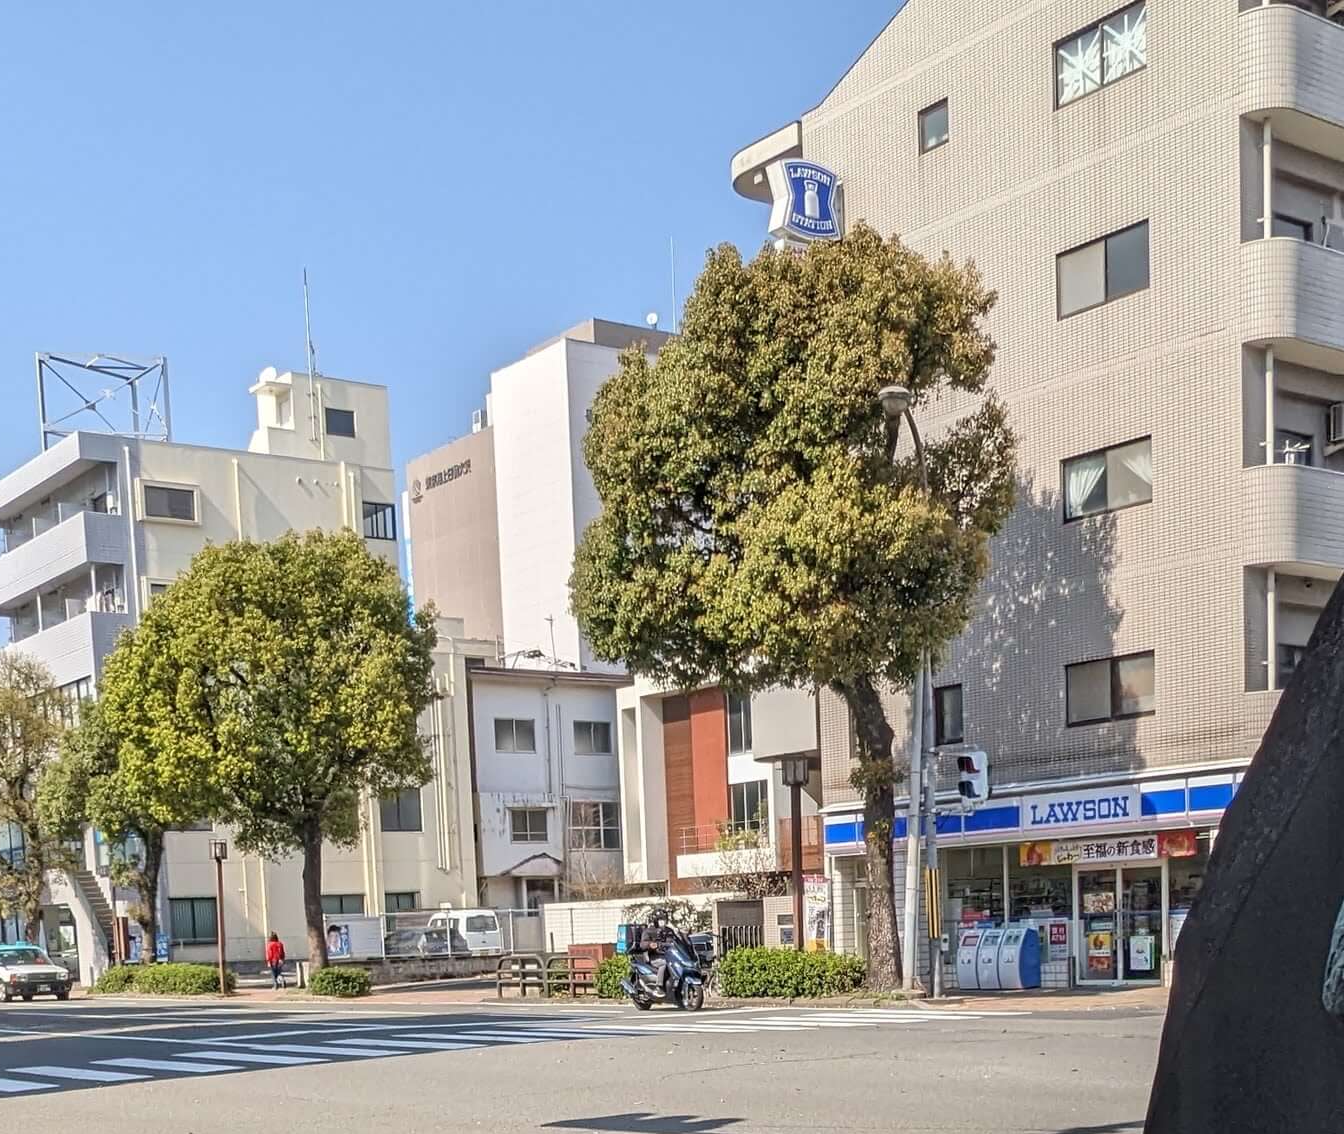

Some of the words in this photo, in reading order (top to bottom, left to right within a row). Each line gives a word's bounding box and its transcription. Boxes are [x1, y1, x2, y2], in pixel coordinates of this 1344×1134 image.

[789, 167, 831, 187] LAWSON
[792, 212, 833, 231] STATION
[1030, 796, 1129, 825] LAWSON
[1083, 839, 1155, 860] 至福の新食感
